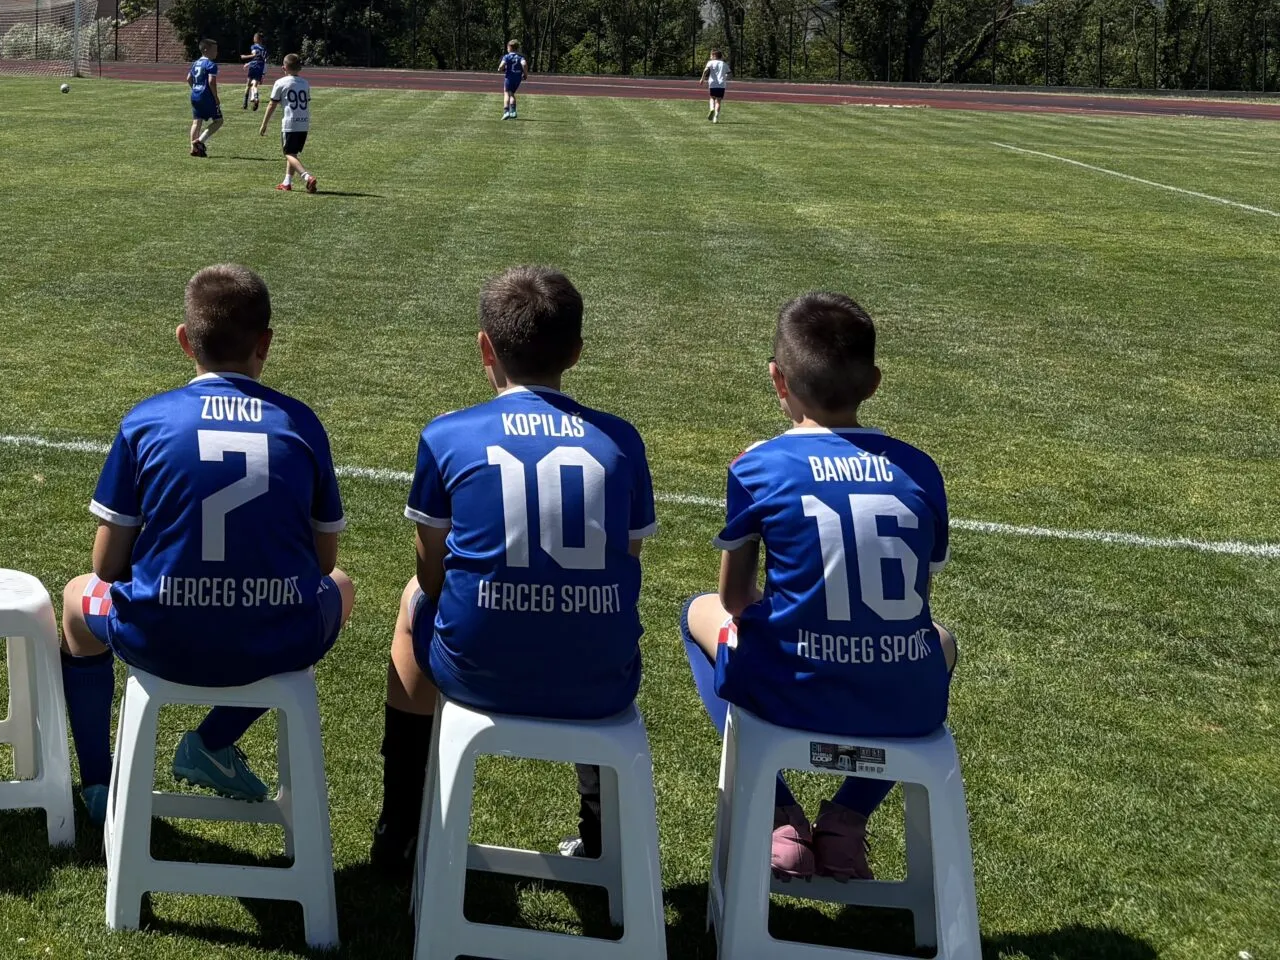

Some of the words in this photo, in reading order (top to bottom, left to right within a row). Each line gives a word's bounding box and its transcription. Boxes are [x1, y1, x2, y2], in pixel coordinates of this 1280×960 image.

[287, 89, 308, 110] 99
[200, 395, 262, 422] ZOVKO
[197, 429, 270, 562] 7
[486, 445, 607, 570] 10
[801, 493, 925, 622] 16
[159, 575, 236, 607] HERCEG
[242, 575, 303, 607] SPORT
[477, 579, 555, 613] HERCEG
[561, 583, 621, 614] SPORT
[797, 628, 875, 664] HERCEG
[880, 628, 933, 664] SPORT
